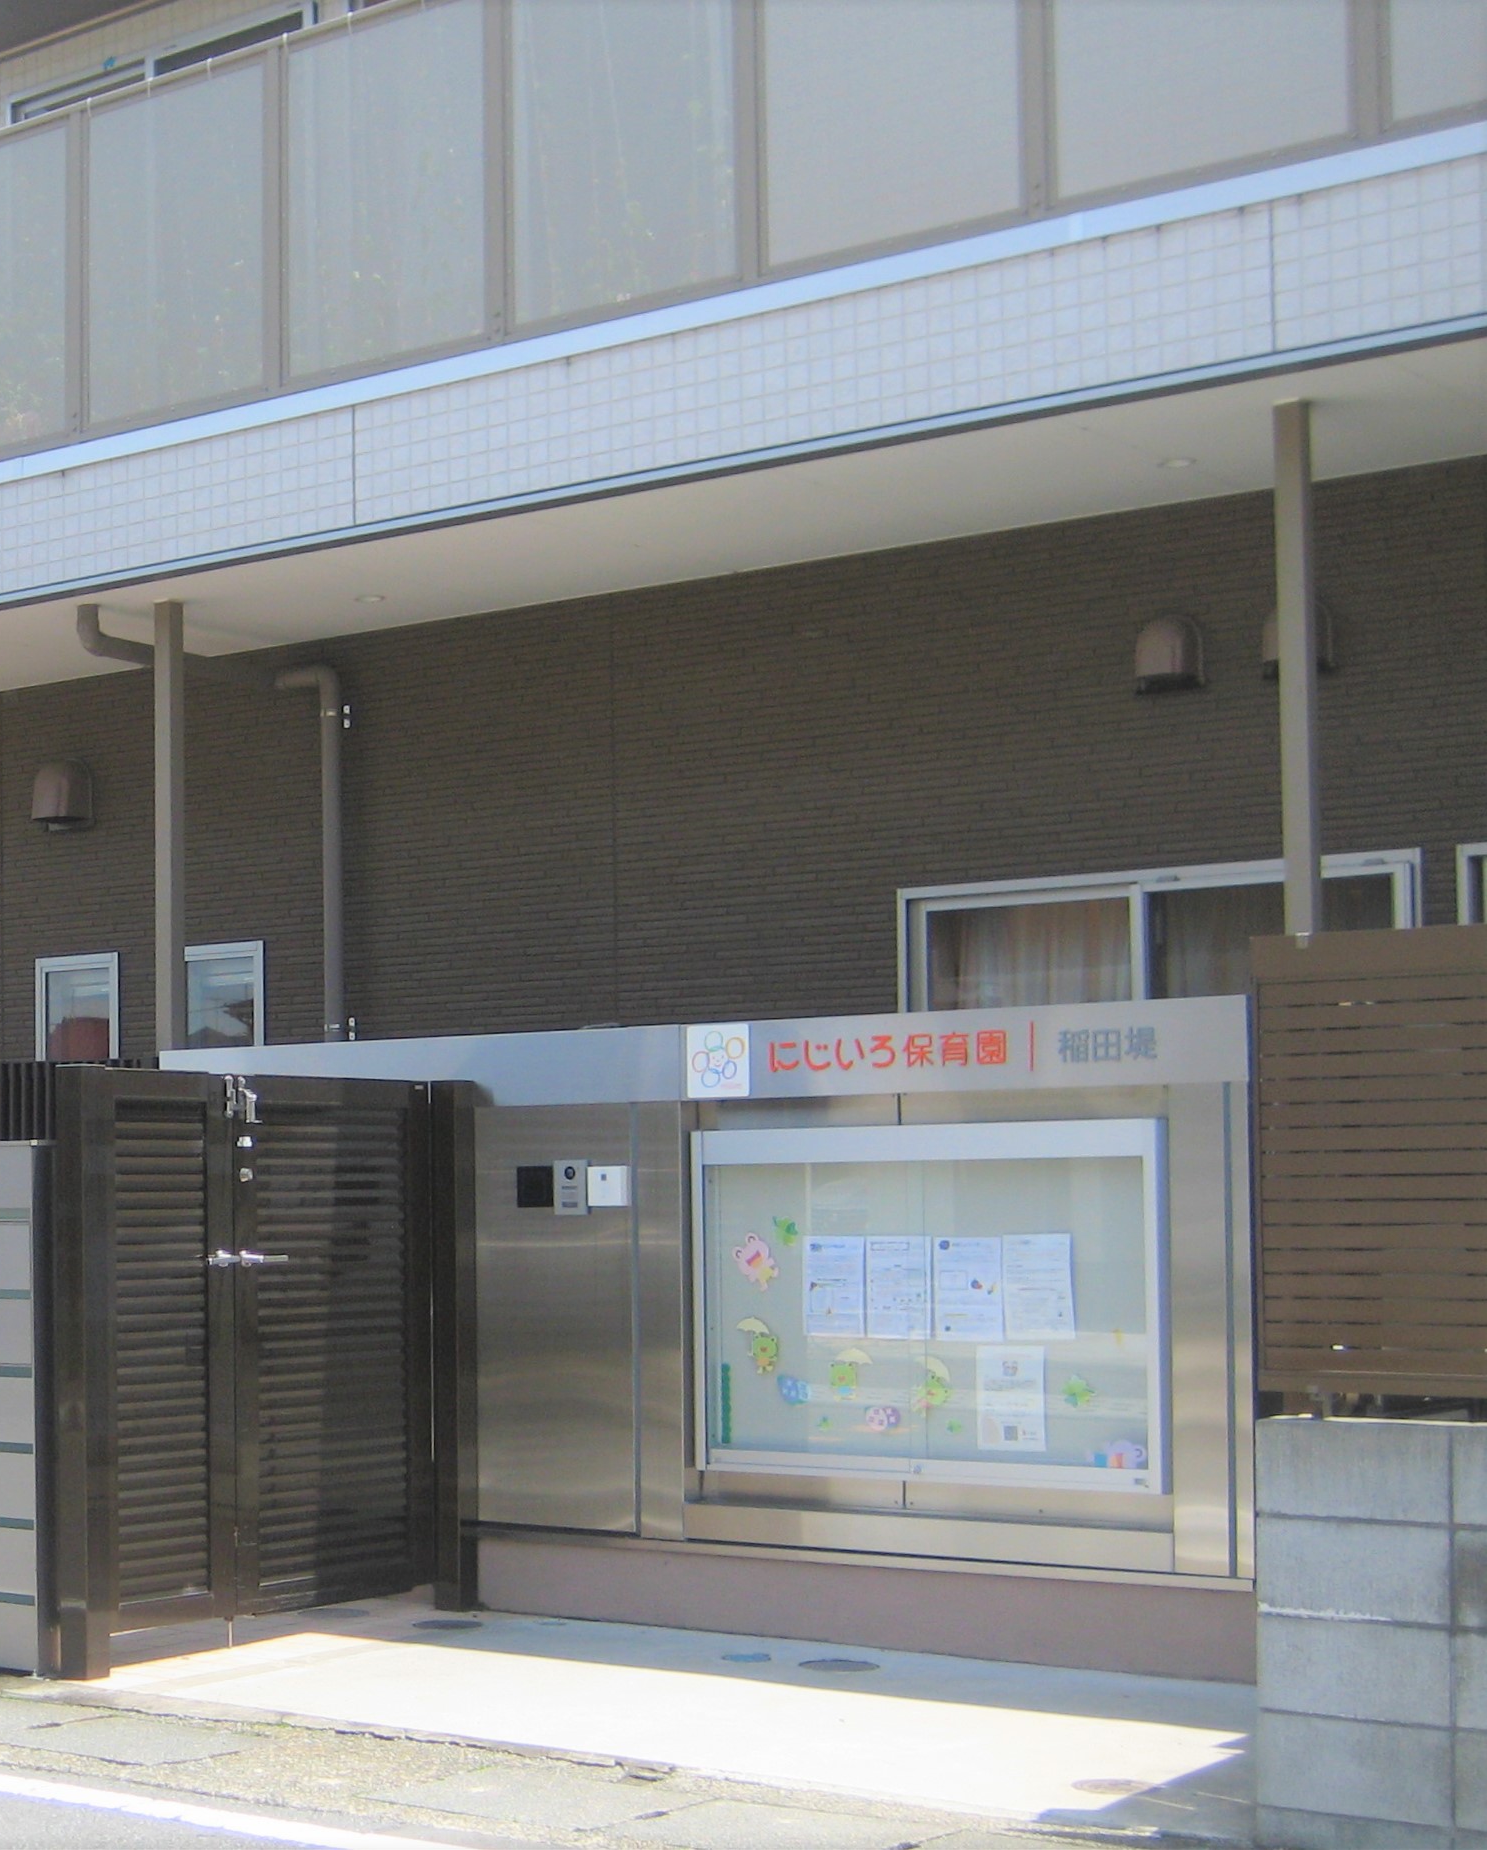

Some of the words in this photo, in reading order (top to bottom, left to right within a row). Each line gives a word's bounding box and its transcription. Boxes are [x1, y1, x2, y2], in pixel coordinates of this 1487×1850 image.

[769, 1029, 1006, 1072] にじいろ保育園
[1058, 1026, 1157, 1063] 稲田堤
